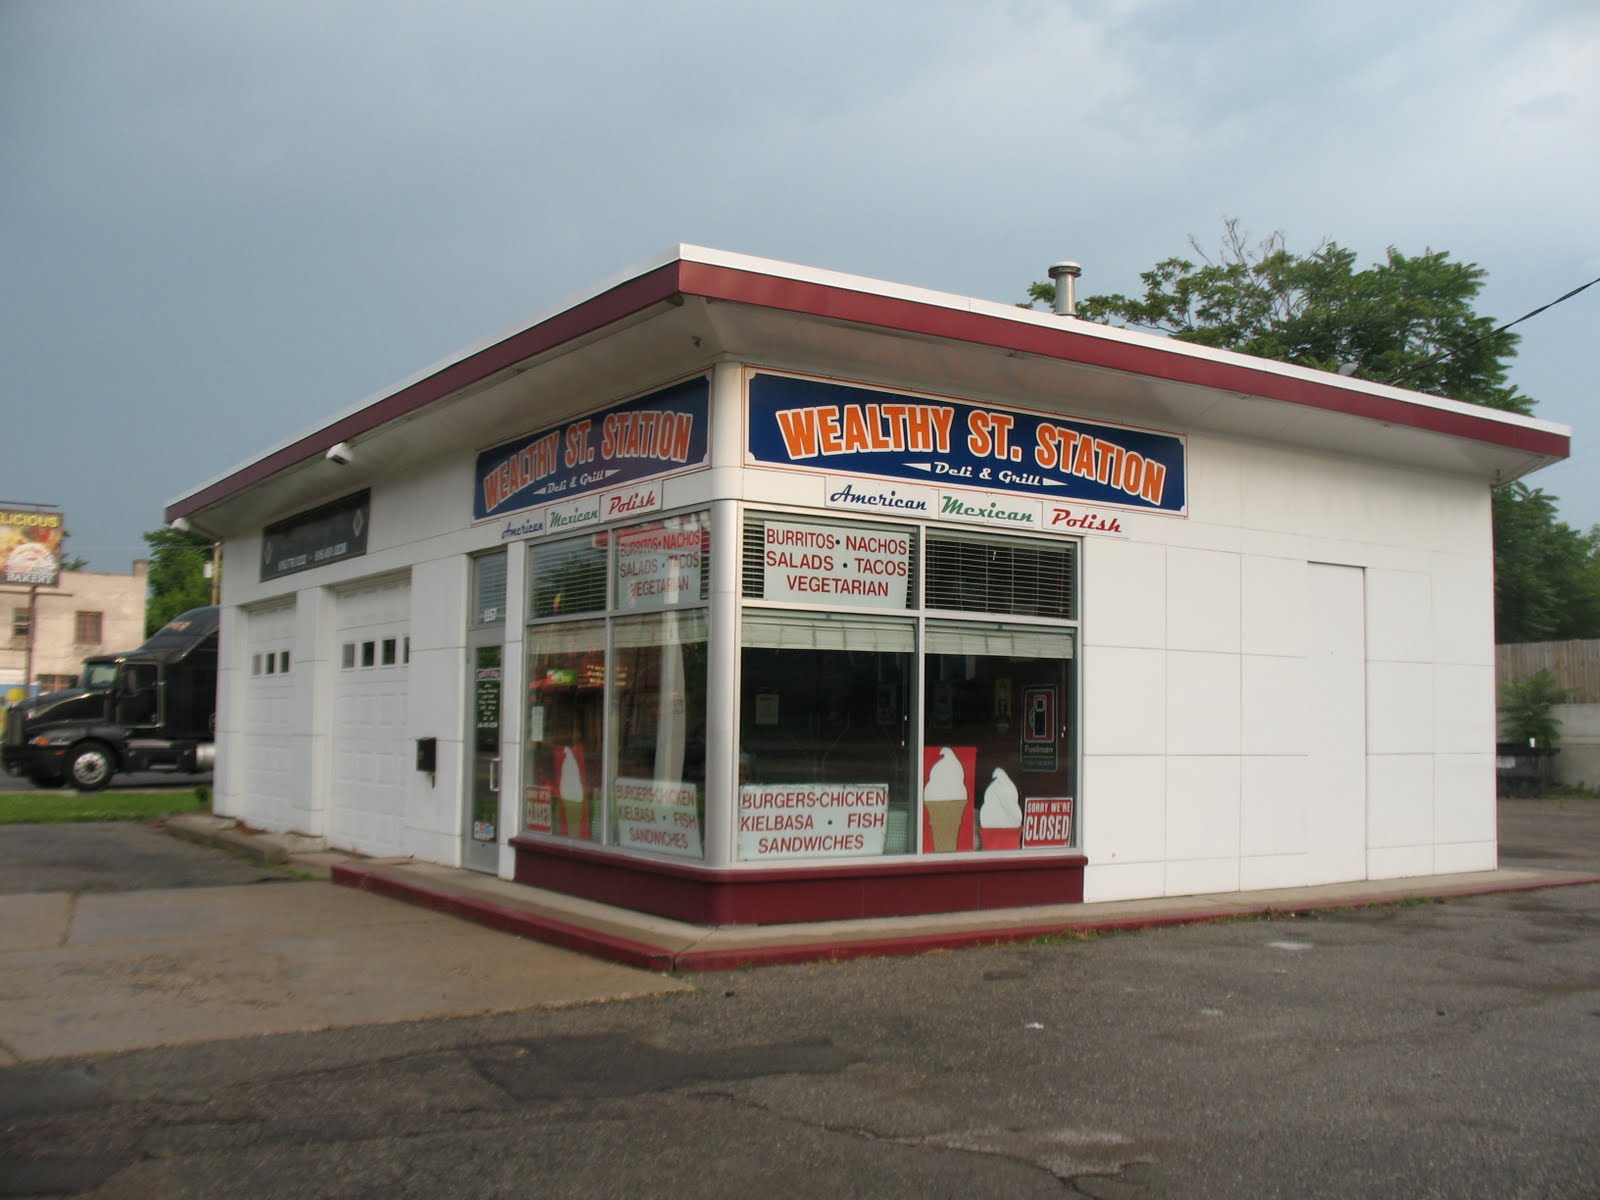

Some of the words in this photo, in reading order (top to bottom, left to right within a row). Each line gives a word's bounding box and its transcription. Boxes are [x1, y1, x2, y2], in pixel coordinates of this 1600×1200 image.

[483, 429, 561, 513] WEALTHY
[565, 419, 595, 468] ST.
[601, 410, 693, 464] STATION
[775, 403, 955, 460] WEALTHY
[968, 409, 1022, 462] ST.
[1035, 422, 1167, 506] STATION
[545, 479, 567, 494] Deli
[569, 477, 577, 487] &
[579, 471, 604, 486] Grill
[933, 461, 973, 477] Deli
[979, 467, 993, 480] &
[998, 470, 1041, 486] Grill
[501, 518, 544, 540] American
[549, 507, 599, 528] Mexican
[608, 490, 656, 515] Polish
[830, 484, 927, 511] American
[941, 495, 1034, 523] Mexican
[1051, 508, 1122, 533] Polish
[663, 530, 700, 550] NACHOS
[766, 528, 836, 550] BURRITOS
[845, 535, 907, 555] NACHOS
[620, 558, 658, 578] SALADS
[766, 550, 834, 571] SALADS
[855, 557, 907, 576] TACOS
[787, 574, 889, 597] VEGETARIAN
[819, 791, 886, 808] CHICKEN
[1027, 801, 1049, 813] SORRY
[1051, 801, 1071, 812] WE'RE
[673, 811, 697, 829] FISH
[740, 814, 815, 832] KIELBASA
[847, 812, 885, 828] FISH
[1025, 813, 1070, 841] CLOSED
[628, 827, 689, 849] SANDWICHES
[758, 834, 864, 854] SANDWICHES
